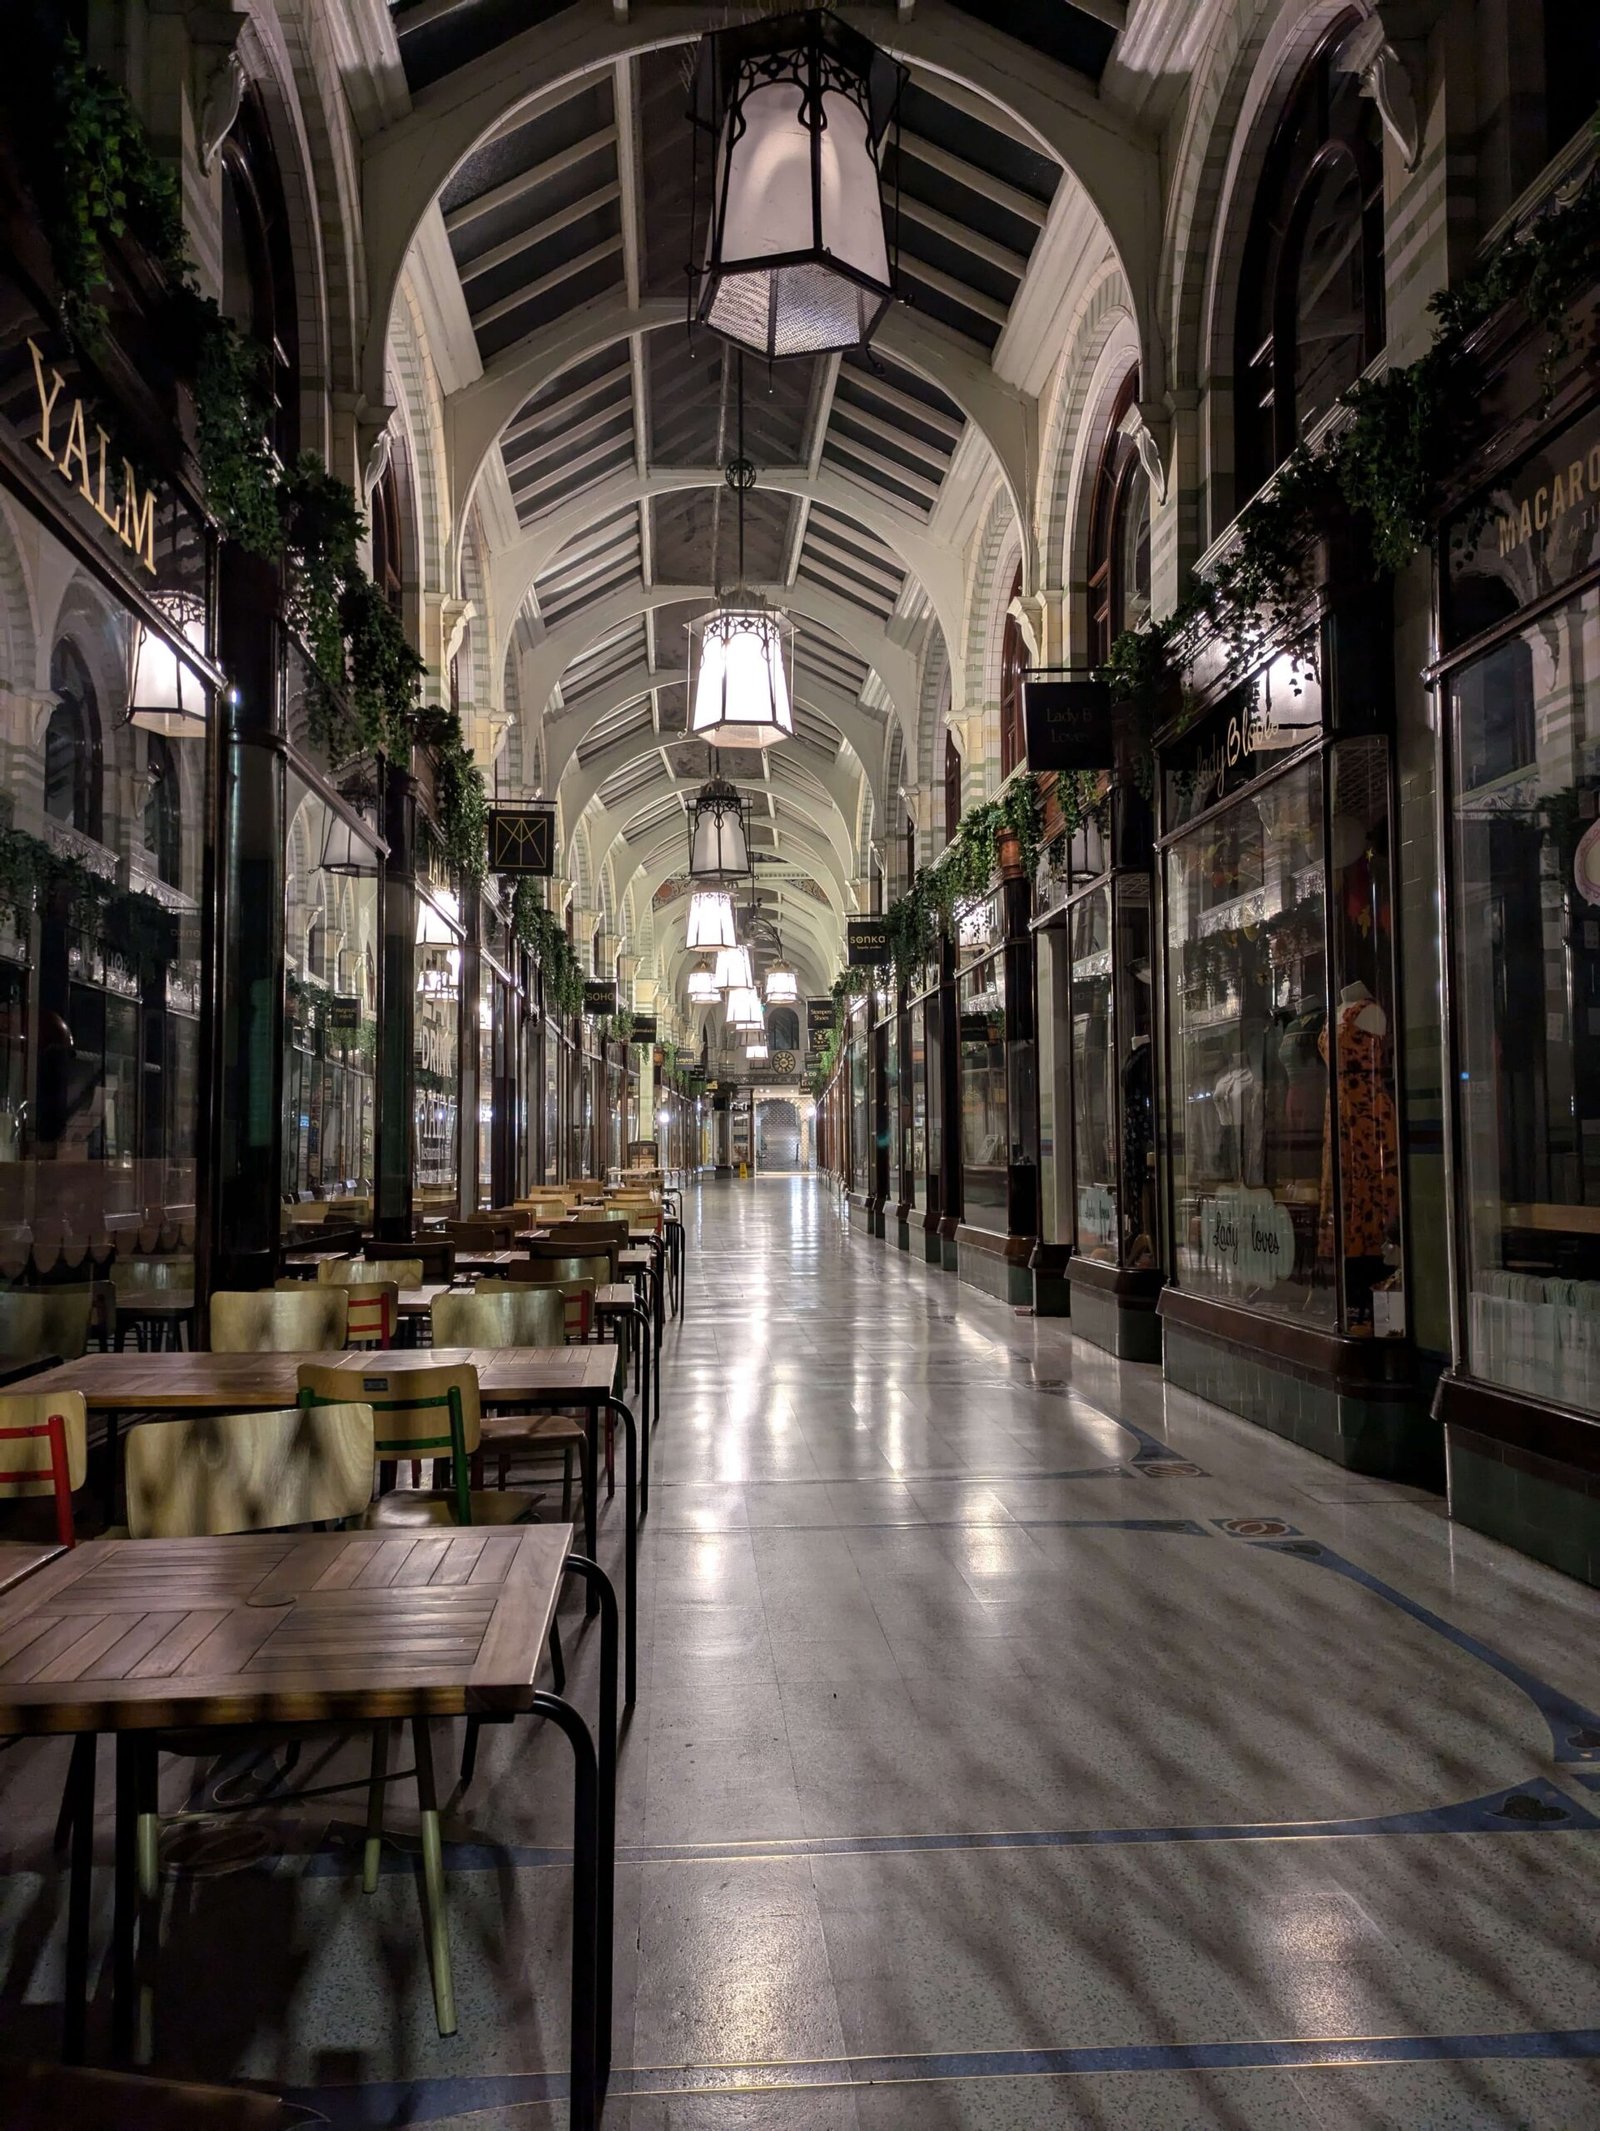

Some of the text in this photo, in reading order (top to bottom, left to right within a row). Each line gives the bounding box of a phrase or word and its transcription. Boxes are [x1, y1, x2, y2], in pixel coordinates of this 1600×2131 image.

[27, 337, 158, 576] YALM
[849, 934, 886, 944] sonka
[585, 992, 615, 1002] SOHO
[1213, 1211, 1279, 1265] Lady loves
